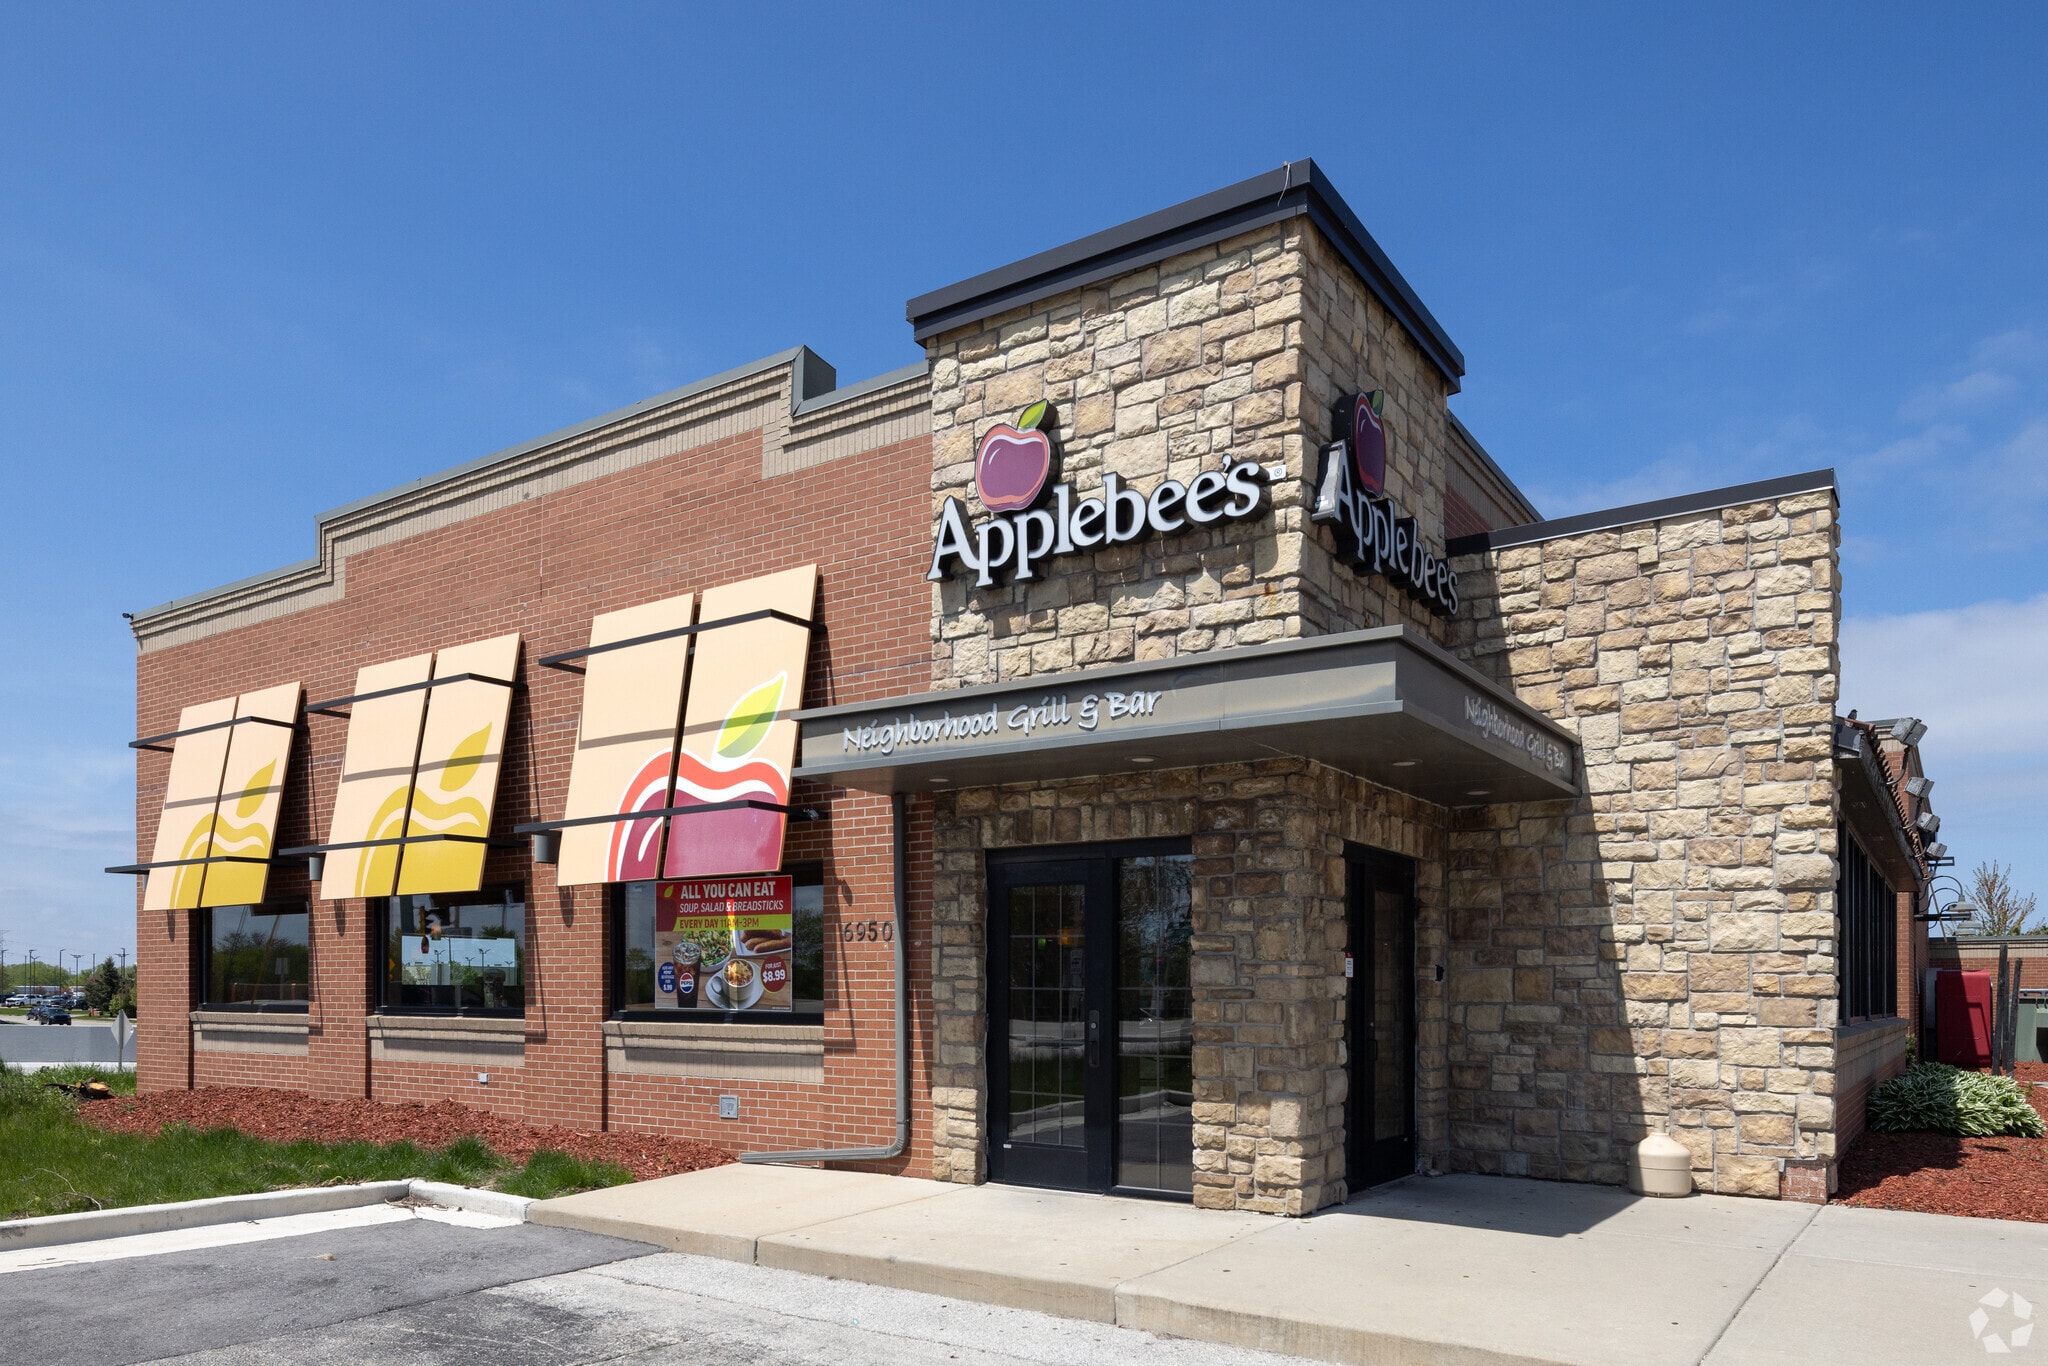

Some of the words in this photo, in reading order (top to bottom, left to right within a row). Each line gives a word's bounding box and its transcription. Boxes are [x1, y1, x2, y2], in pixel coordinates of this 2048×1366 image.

[925, 454, 1262, 588] Applebee's
[1333, 439, 1459, 616] Applebee's
[842, 702, 999, 754] Neighborhood
[1006, 695, 1072, 735] Grill
[1078, 693, 1100, 729] &
[1104, 690, 1163, 718] Bar
[1464, 695, 1525, 750] Neighborhood
[680, 884, 701, 900] ALL
[702, 883, 726, 899] YOU
[727, 882, 752, 898] CAN
[753, 881, 776, 896] EAT
[679, 902, 700, 914] SOUP,
[700, 902, 725, 913] SALAD
[725, 901, 732, 912] &
[732, 899, 784, 912] BREADSTICKS
[679, 918, 703, 929] EVERY
[704, 918, 719, 929] DAY
[843, 920, 893, 943] 6950
[762, 969, 786, 984] $8.99
